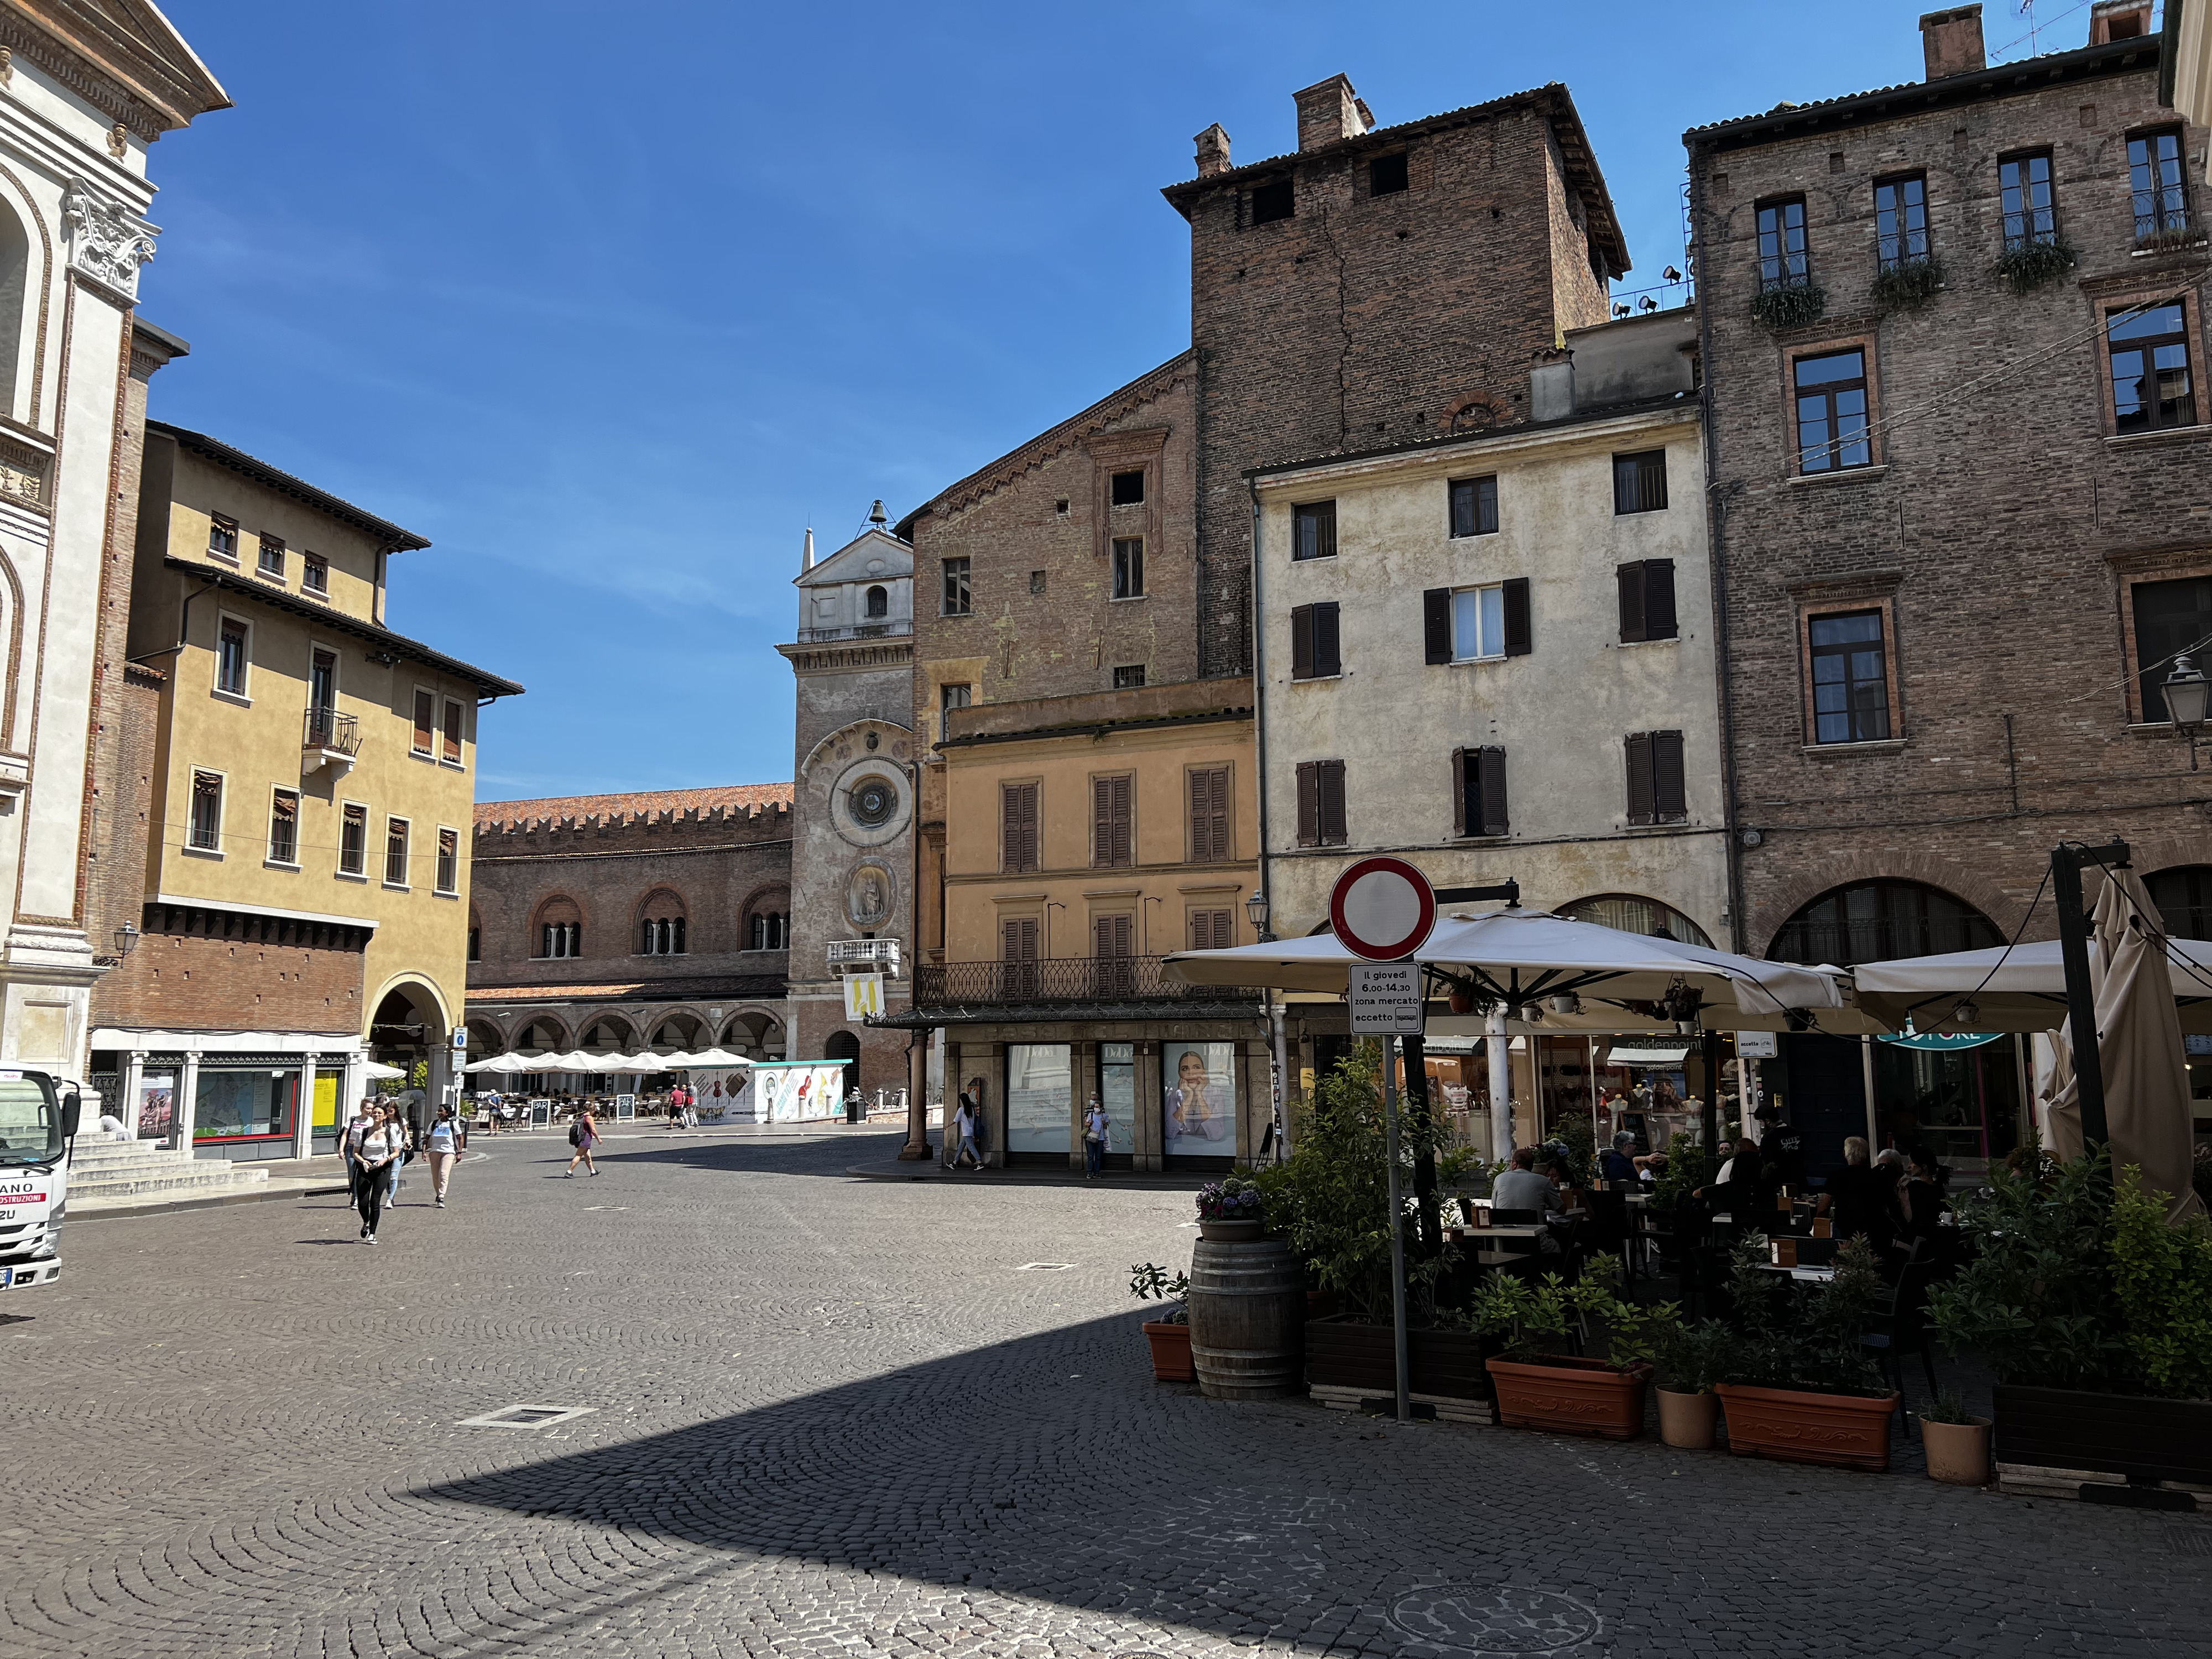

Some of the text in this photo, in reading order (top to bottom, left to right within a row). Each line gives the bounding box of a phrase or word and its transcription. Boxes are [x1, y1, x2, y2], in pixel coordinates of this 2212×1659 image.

[1364, 971, 1370, 979] il
[1105, 1046, 1133, 1058] DoDo
[533, 1101, 547, 1110] BAR
[618, 1097, 633, 1107] BAR
